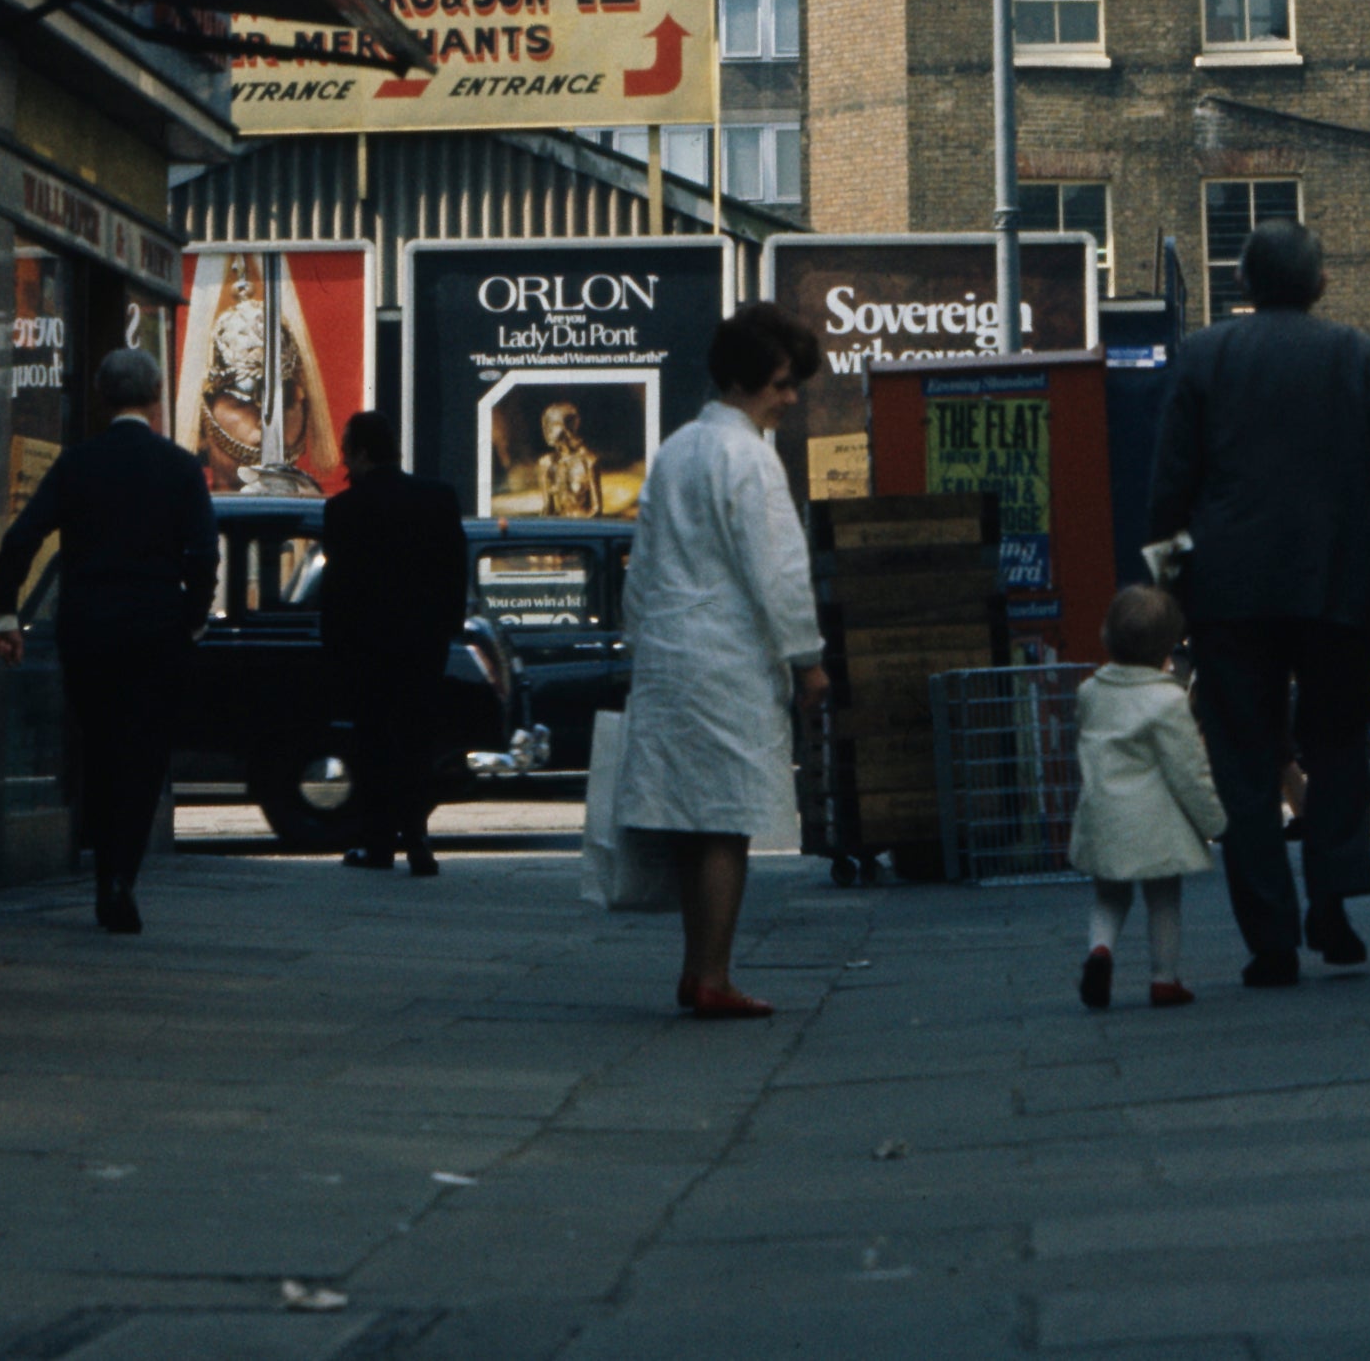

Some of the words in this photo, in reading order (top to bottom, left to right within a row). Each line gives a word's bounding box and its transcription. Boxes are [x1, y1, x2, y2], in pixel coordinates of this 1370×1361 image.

[450, 74, 604, 98] ENTRANCE
[478, 274, 660, 313] ORLON
[499, 323, 549, 354] Lady
[552, 324, 586, 347] Du
[589, 323, 638, 348] Pont
[496, 353, 524, 366] Most
[524, 352, 567, 365] Wanted
[567, 352, 611, 364] Woman
[612, 354, 629, 364] on
[927, 378, 981, 395] Evening
[985, 373, 1046, 390] Standard
[935, 403, 980, 449] THE
[985, 403, 1042, 449] FLAT
[986, 449, 1040, 477] AJAX
[999, 536, 1037, 564] ing
[486, 595, 509, 609] You
[509, 597, 532, 608] can
[532, 594, 556, 608] win
